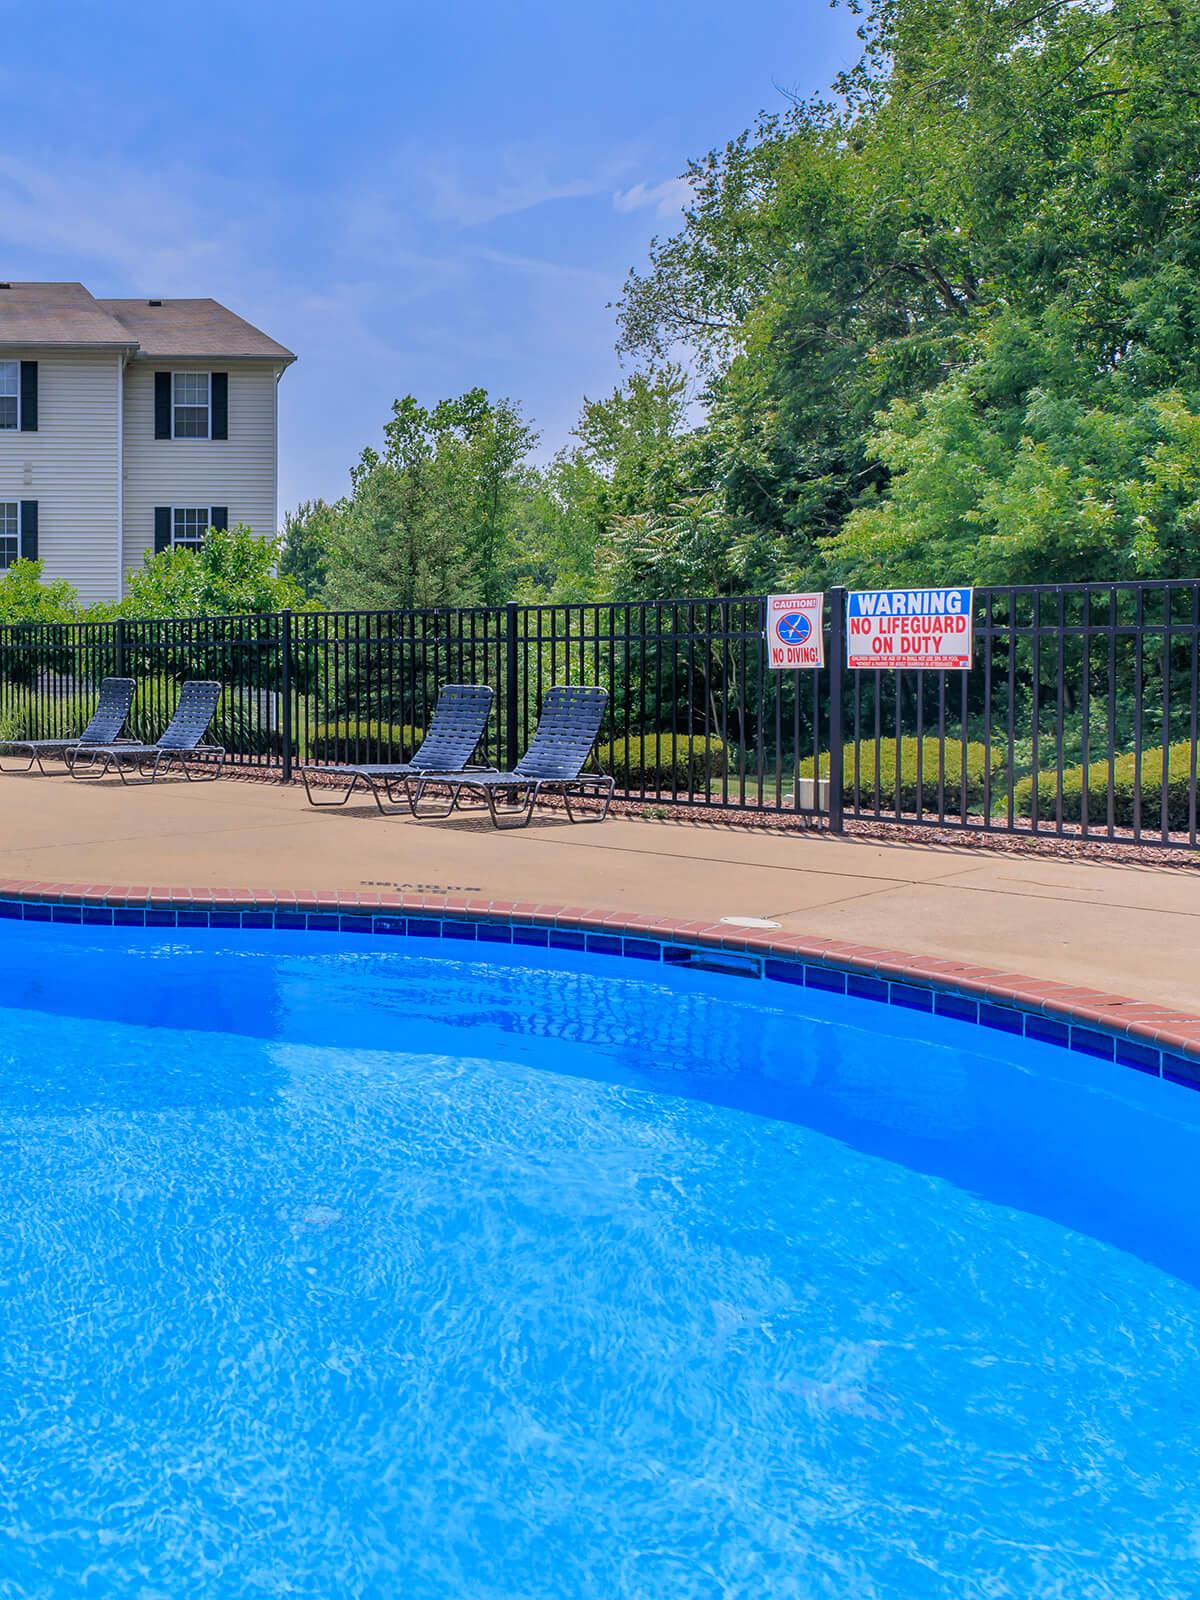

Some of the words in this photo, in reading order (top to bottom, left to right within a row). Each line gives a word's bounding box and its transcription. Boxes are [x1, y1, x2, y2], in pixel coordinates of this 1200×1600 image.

[774, 599, 816, 609] CAUTION!
[858, 592, 961, 615] WARNING
[850, 617, 872, 635] NO
[879, 616, 966, 634] LIFEGUARD
[872, 636, 893, 654] ON
[901, 636, 943, 654] DUTY
[773, 648, 785, 664] NO
[787, 647, 818, 664] DIVING!
